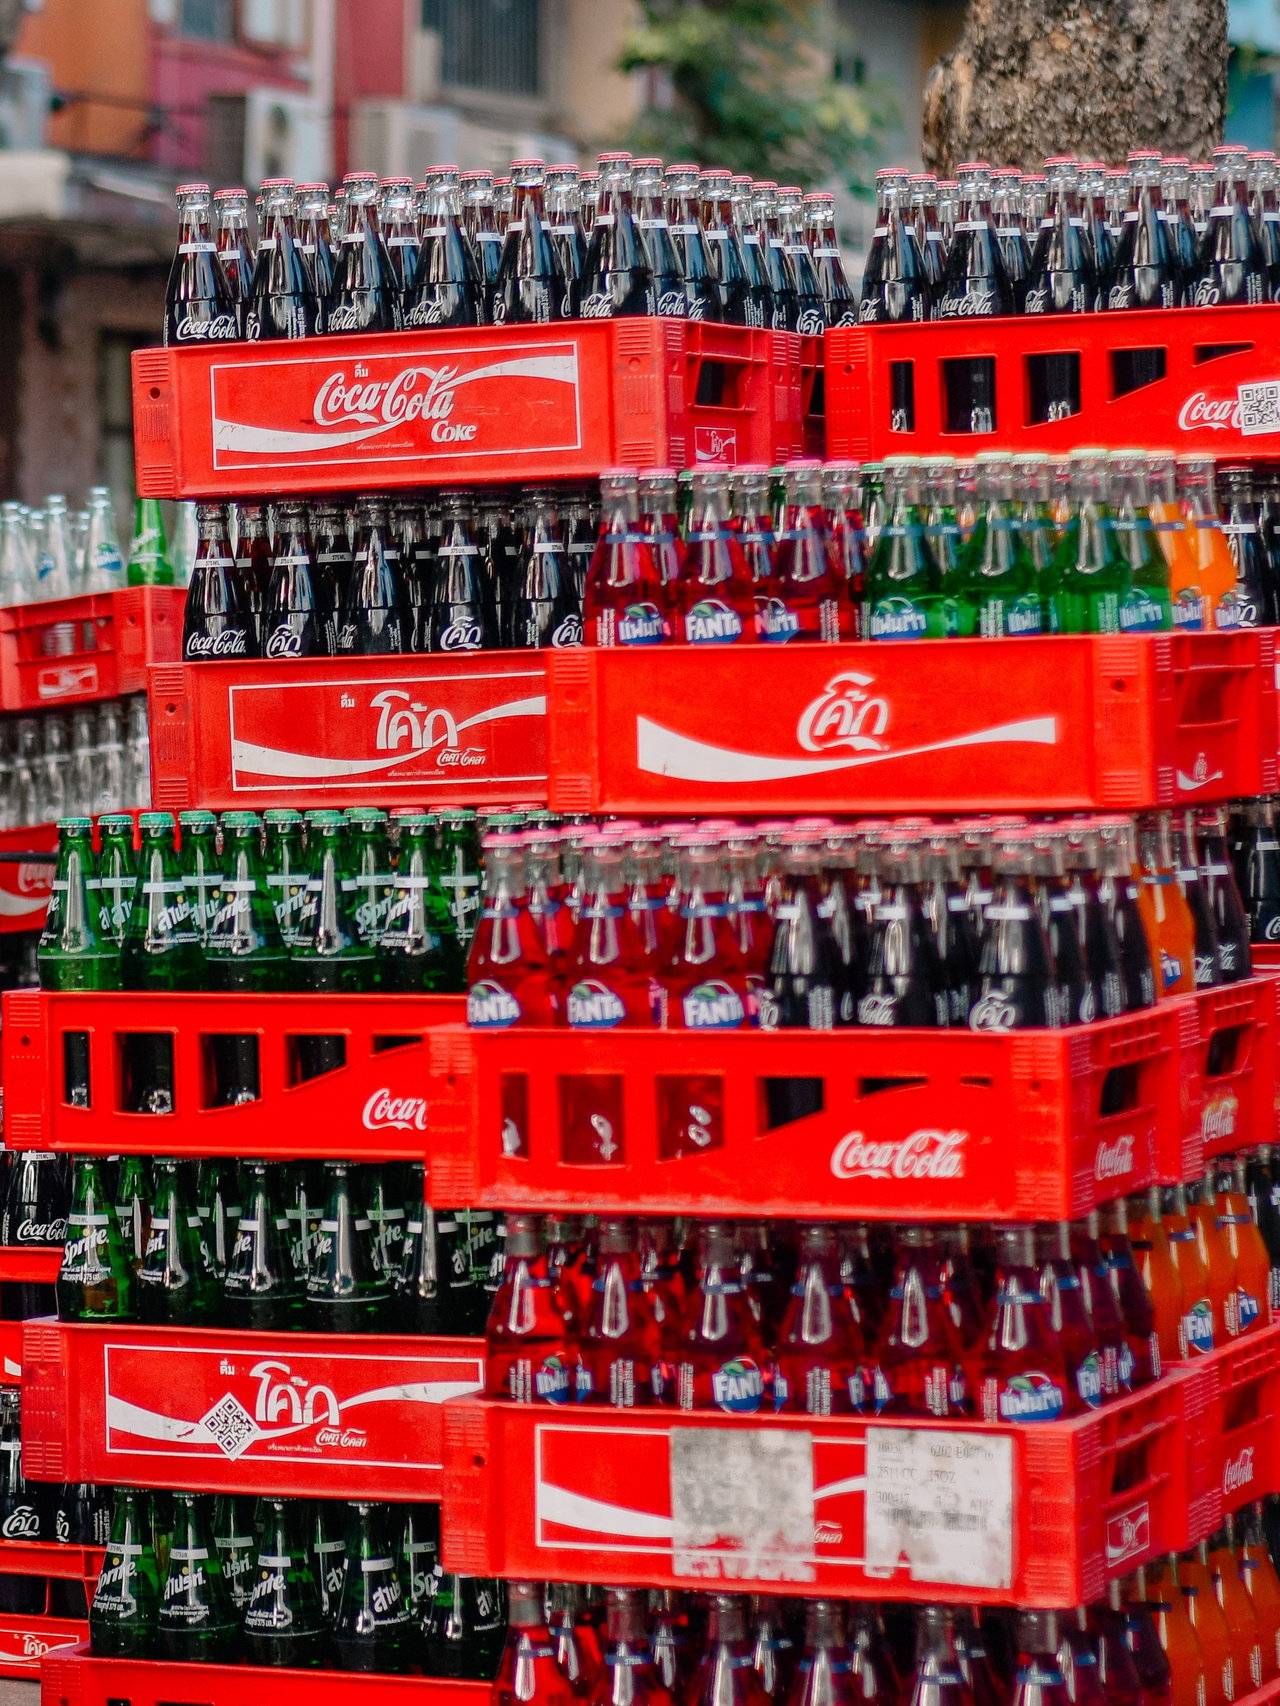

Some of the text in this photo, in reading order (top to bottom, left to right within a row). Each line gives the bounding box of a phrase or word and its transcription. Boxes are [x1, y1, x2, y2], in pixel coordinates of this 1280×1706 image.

[176, 315, 238, 340] Coca-Cola
[313, 365, 458, 426] Coca-Cola
[1178, 392, 1242, 431] Coca-
[431, 420, 477, 443] Coke
[186, 629, 246, 657] Coca-Cola
[440, 616, 482, 651] โค้ก
[685, 611, 742, 642] FANTA
[370, 690, 458, 750] โค้ก
[797, 671, 888, 752] โค้ก
[569, 993, 625, 1023] FANTA
[684, 993, 744, 1027] FANTA
[362, 1087, 427, 1130] Coca-
[830, 1129, 969, 1179] Coca-Cola
[17, 1218, 68, 1241] Coca-Col
[61, 1228, 110, 1267] Sprite
[249, 1360, 340, 1426] โค้ก
[712, 1369, 763, 1402] FANT
[2, 1505, 40, 1537] โค้ก
